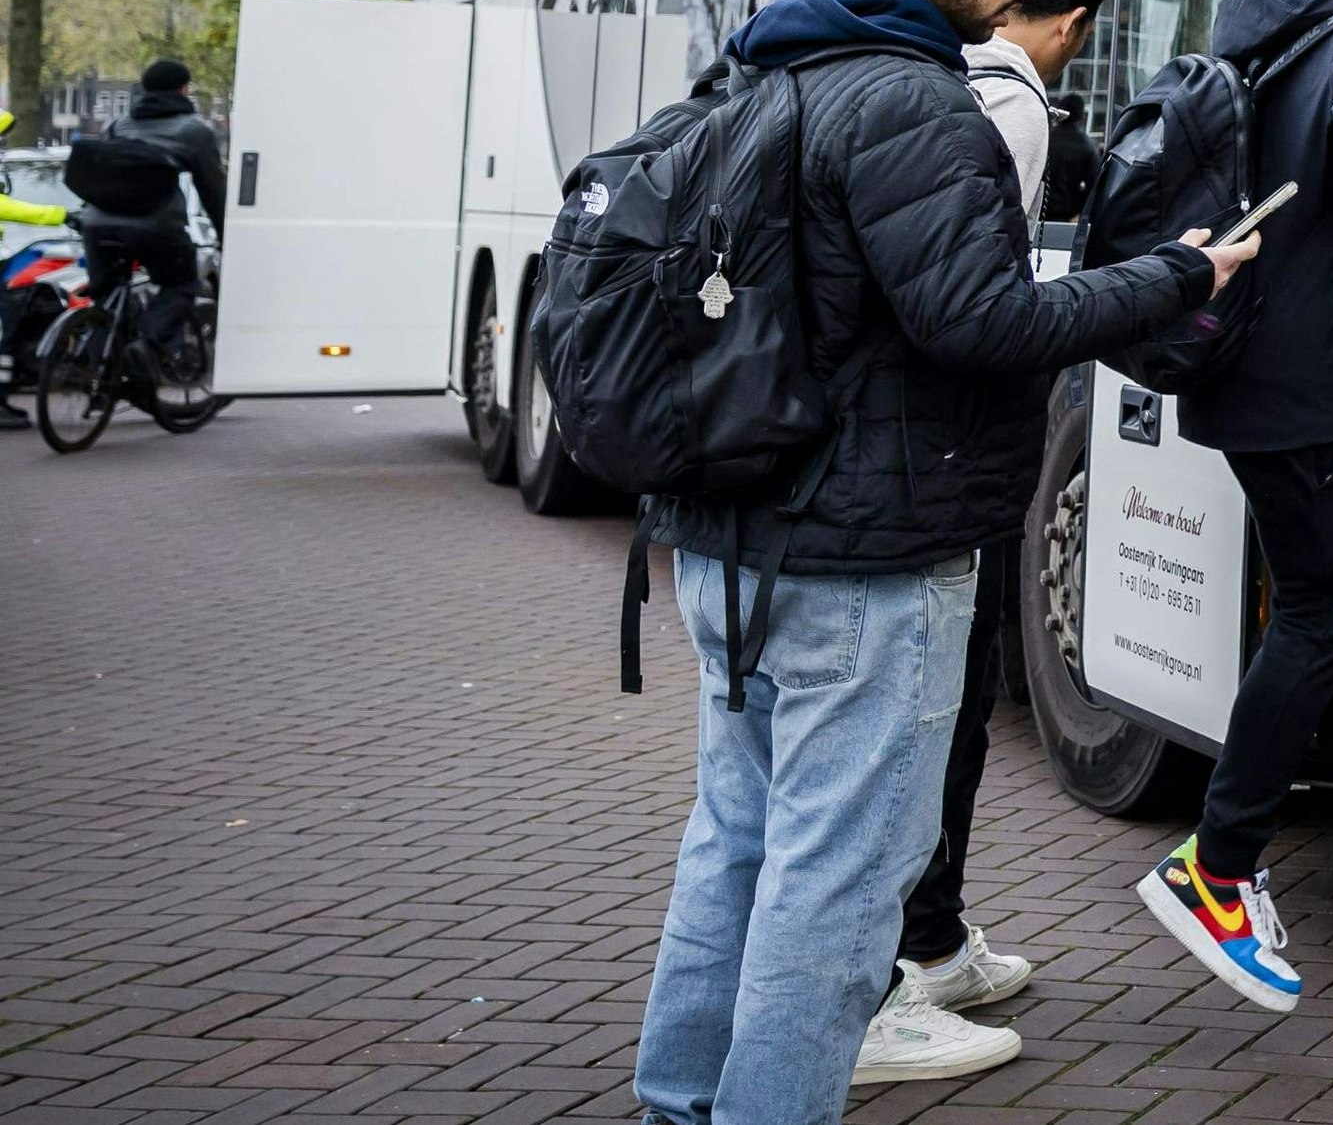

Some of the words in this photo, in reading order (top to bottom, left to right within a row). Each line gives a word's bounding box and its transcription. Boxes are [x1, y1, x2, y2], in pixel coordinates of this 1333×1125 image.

[1123, 486, 1163, 524] Welcome
[1164, 513, 1175, 528] on
[1175, 505, 1206, 536] board
[1119, 542, 1156, 572] Oostenrijk
[1158, 554, 1204, 585] Touringcars
[1167, 588, 1182, 609] 695
[1184, 594, 1194, 613] 25
[1114, 633, 1202, 682] www.oostenrijkgroup.nl
